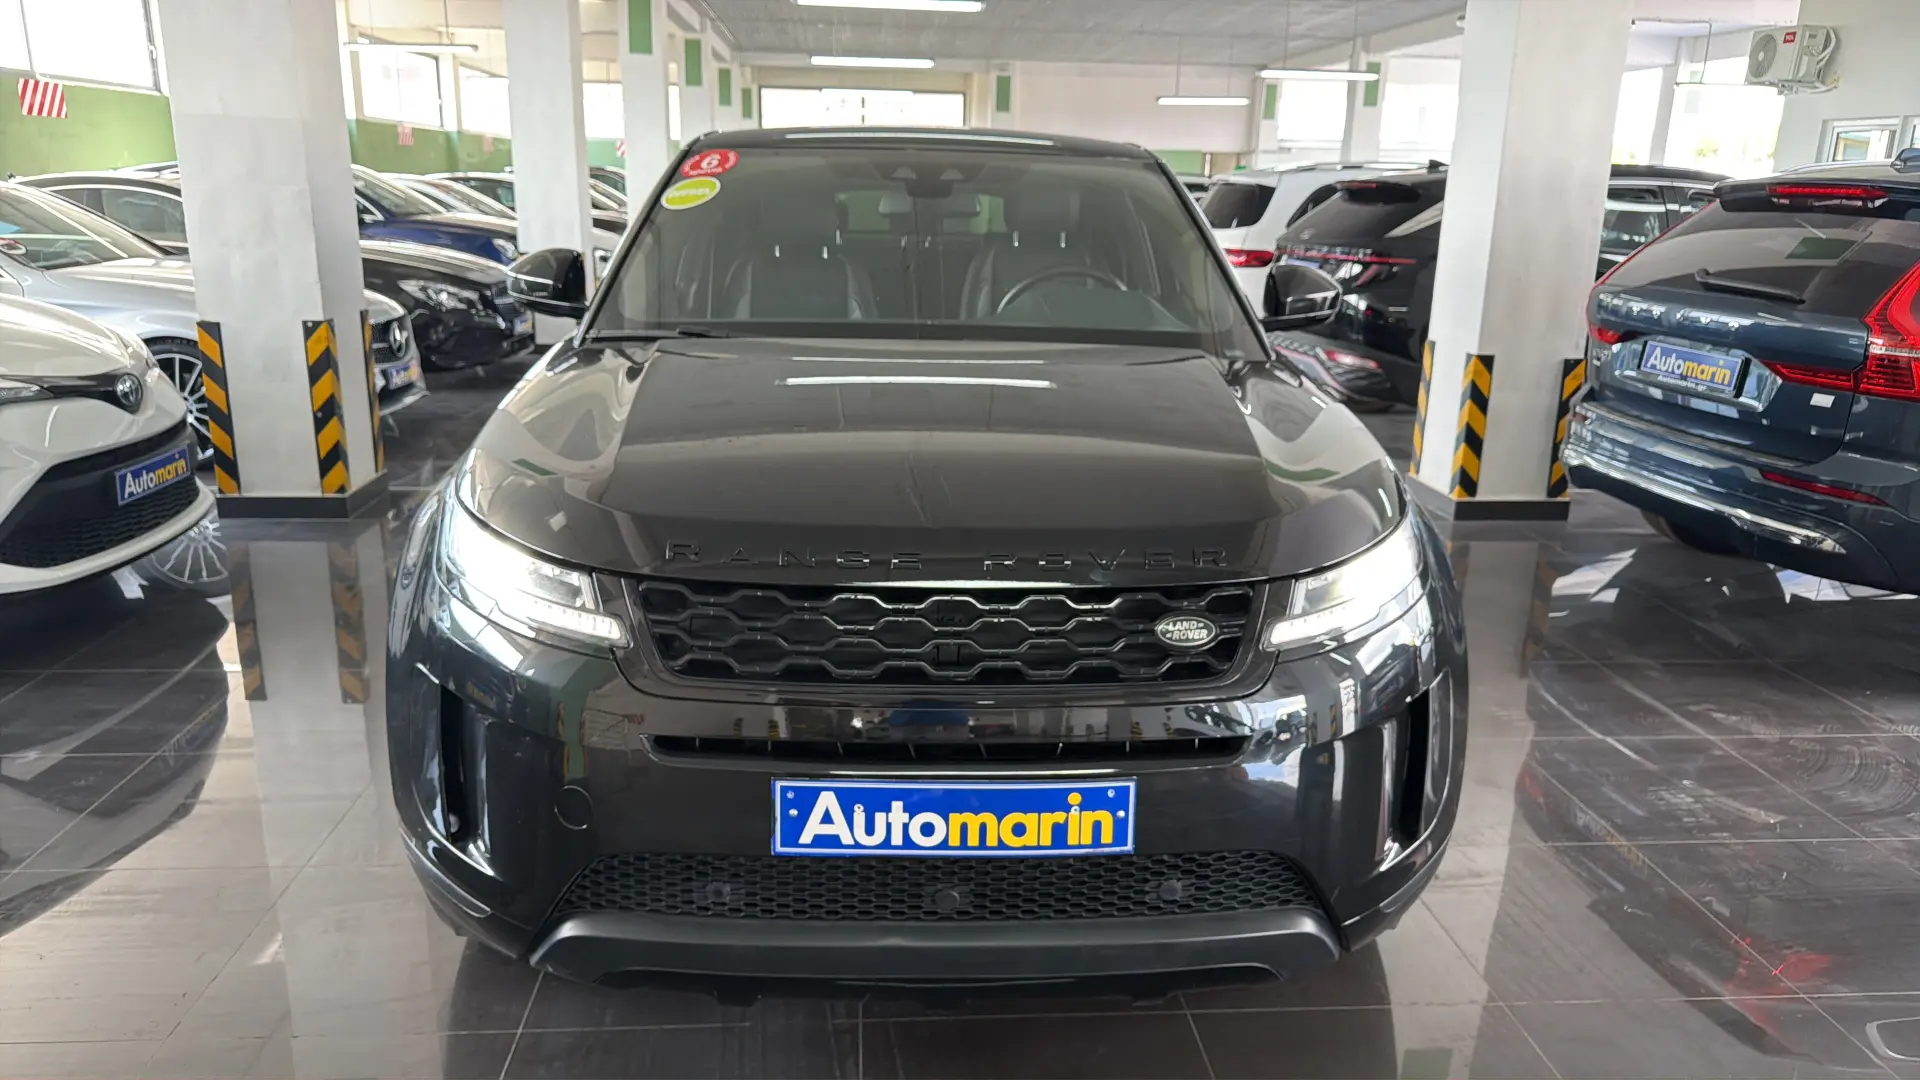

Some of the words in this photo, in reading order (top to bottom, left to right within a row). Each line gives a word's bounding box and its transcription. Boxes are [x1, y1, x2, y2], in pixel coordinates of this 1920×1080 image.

[701, 153, 721, 170] 6
[1647, 346, 1731, 386] Automarin
[124, 453, 187, 499] Automarin
[665, 540, 922, 570] RANGE
[983, 547, 1228, 571] ROVER
[1168, 620, 1197, 631] LAND
[1172, 628, 1208, 640] ROVER
[798, 790, 1114, 848] Automarin
